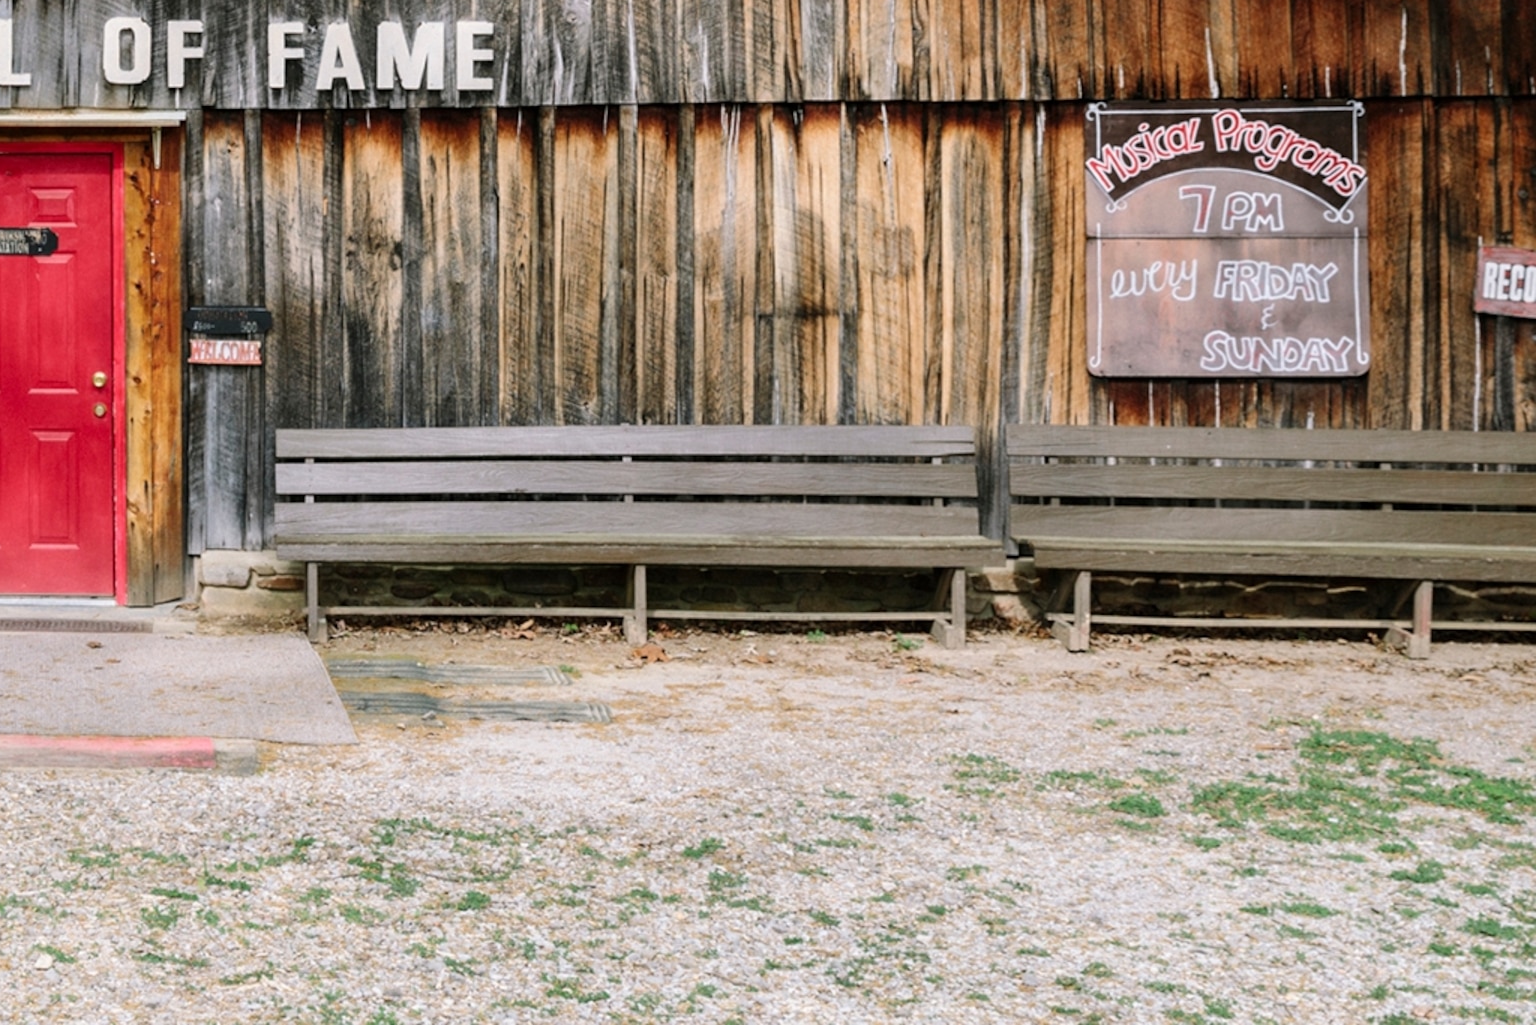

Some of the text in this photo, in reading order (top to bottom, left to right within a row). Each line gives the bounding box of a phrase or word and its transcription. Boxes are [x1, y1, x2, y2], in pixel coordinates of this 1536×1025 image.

[102, 16, 205, 89] OF
[266, 20, 495, 92] FAME
[1212, 108, 1366, 197] Programs
[1179, 185, 1284, 233] 7 PM
[1109, 258, 1339, 303] every FRIDAY
[1200, 330, 1355, 373] SUNDAY
